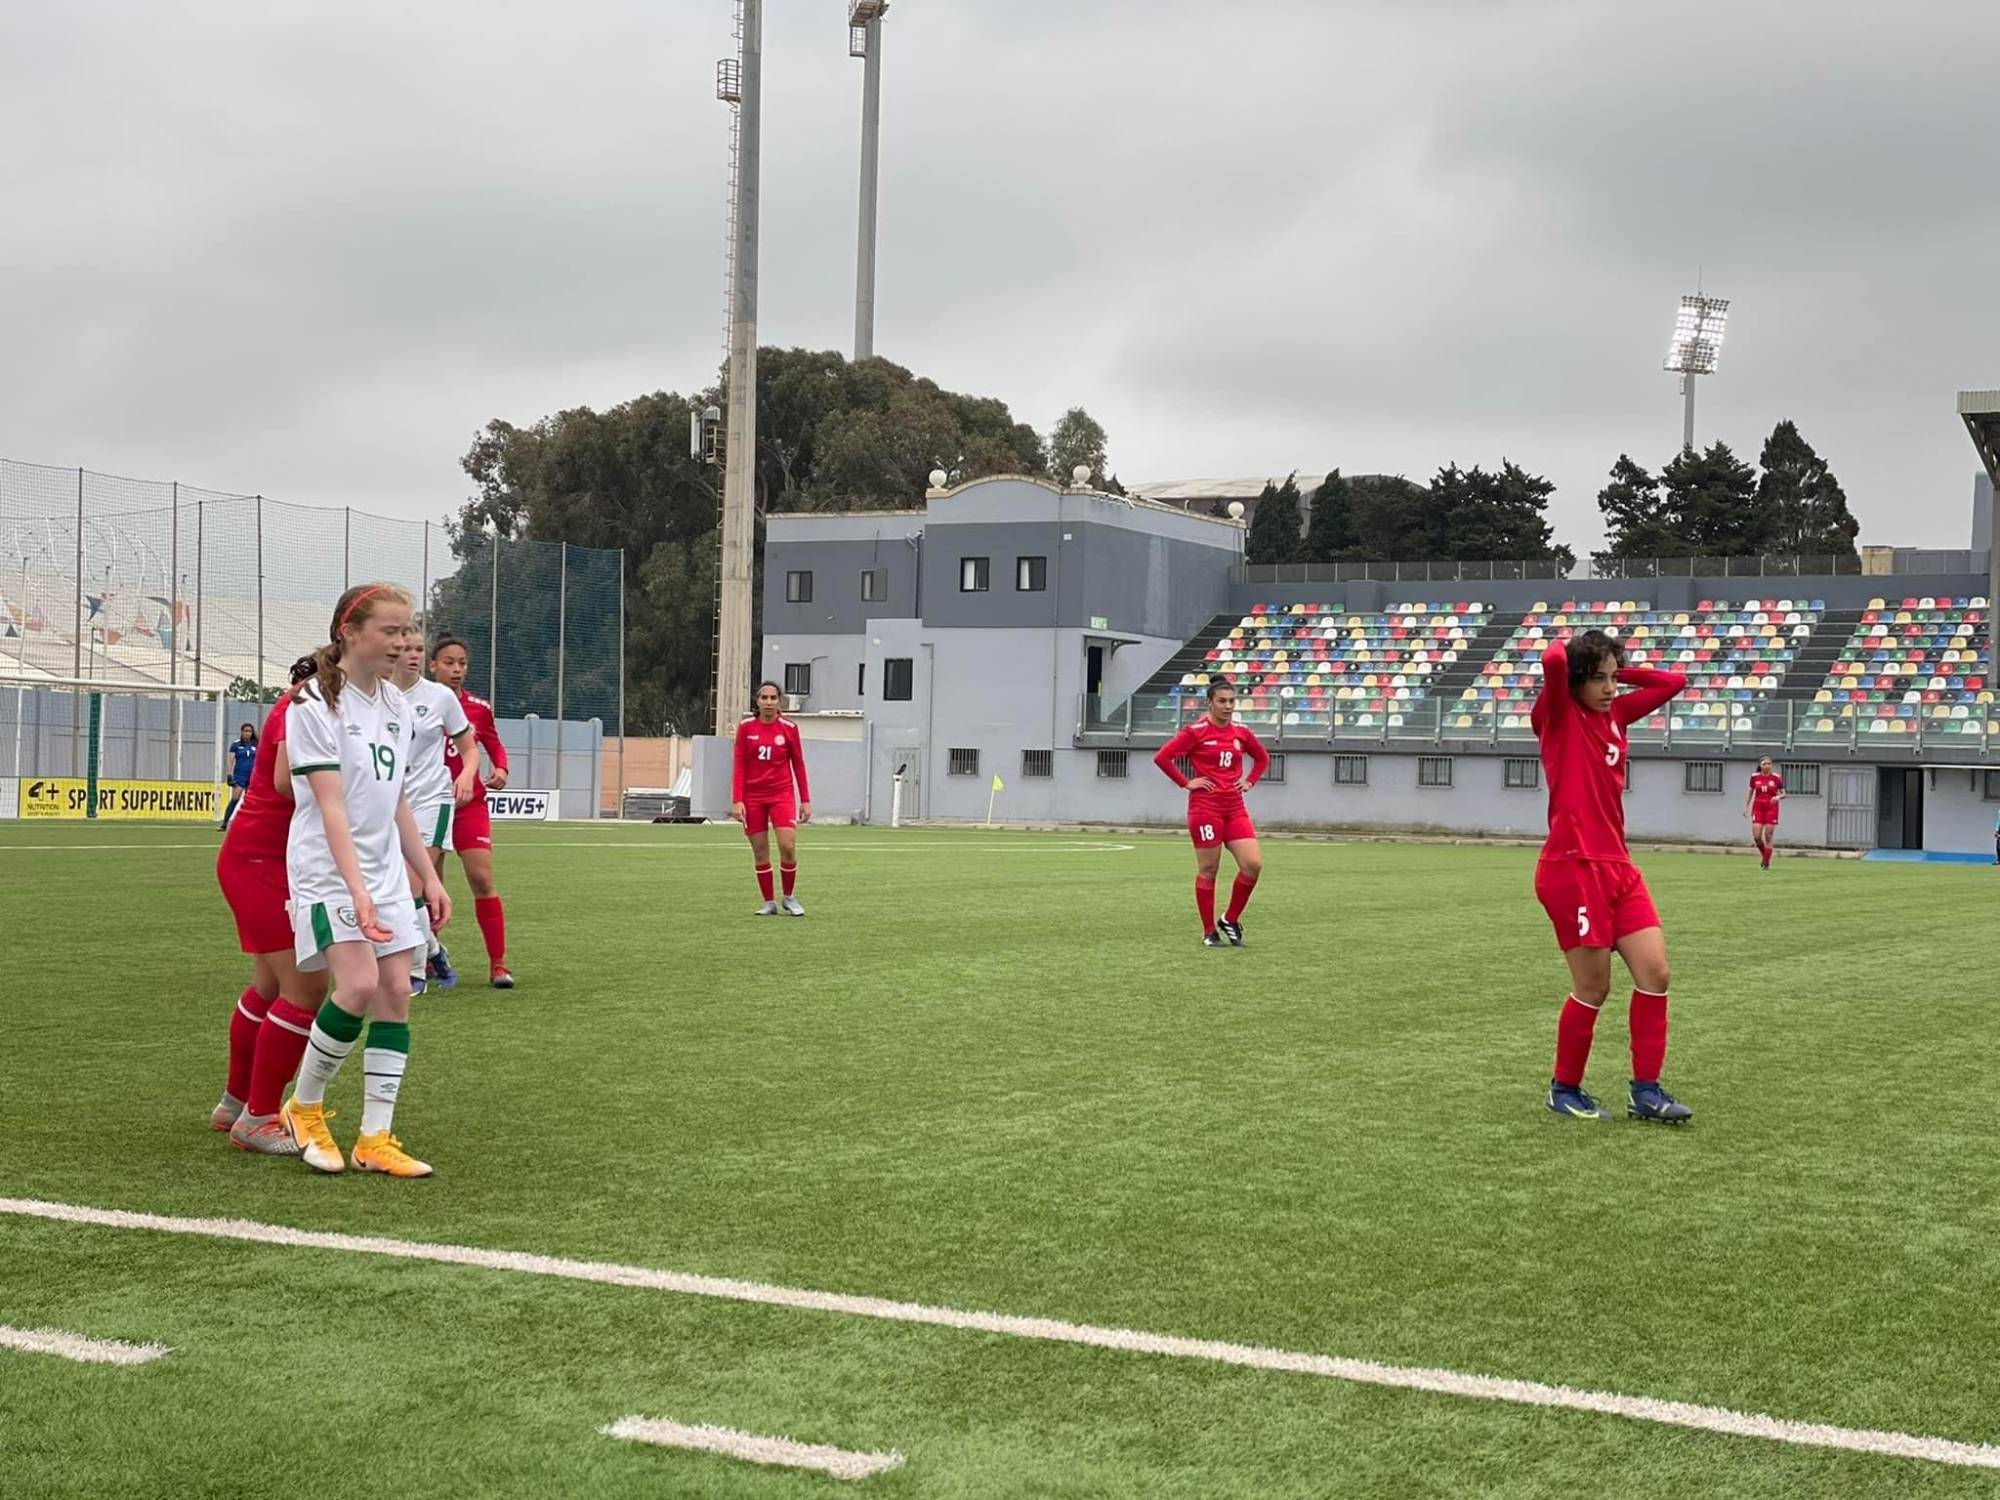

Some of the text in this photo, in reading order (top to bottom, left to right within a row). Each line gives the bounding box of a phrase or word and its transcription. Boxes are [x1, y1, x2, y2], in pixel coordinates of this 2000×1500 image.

[368, 743, 396, 781] 19
[758, 745, 771, 760] 21
[1219, 751, 1233, 767] 18
[1605, 743, 1620, 765] 5
[68, 789, 116, 810] SPRT
[1200, 824, 1215, 841] 18
[1577, 906, 1590, 937] 5
